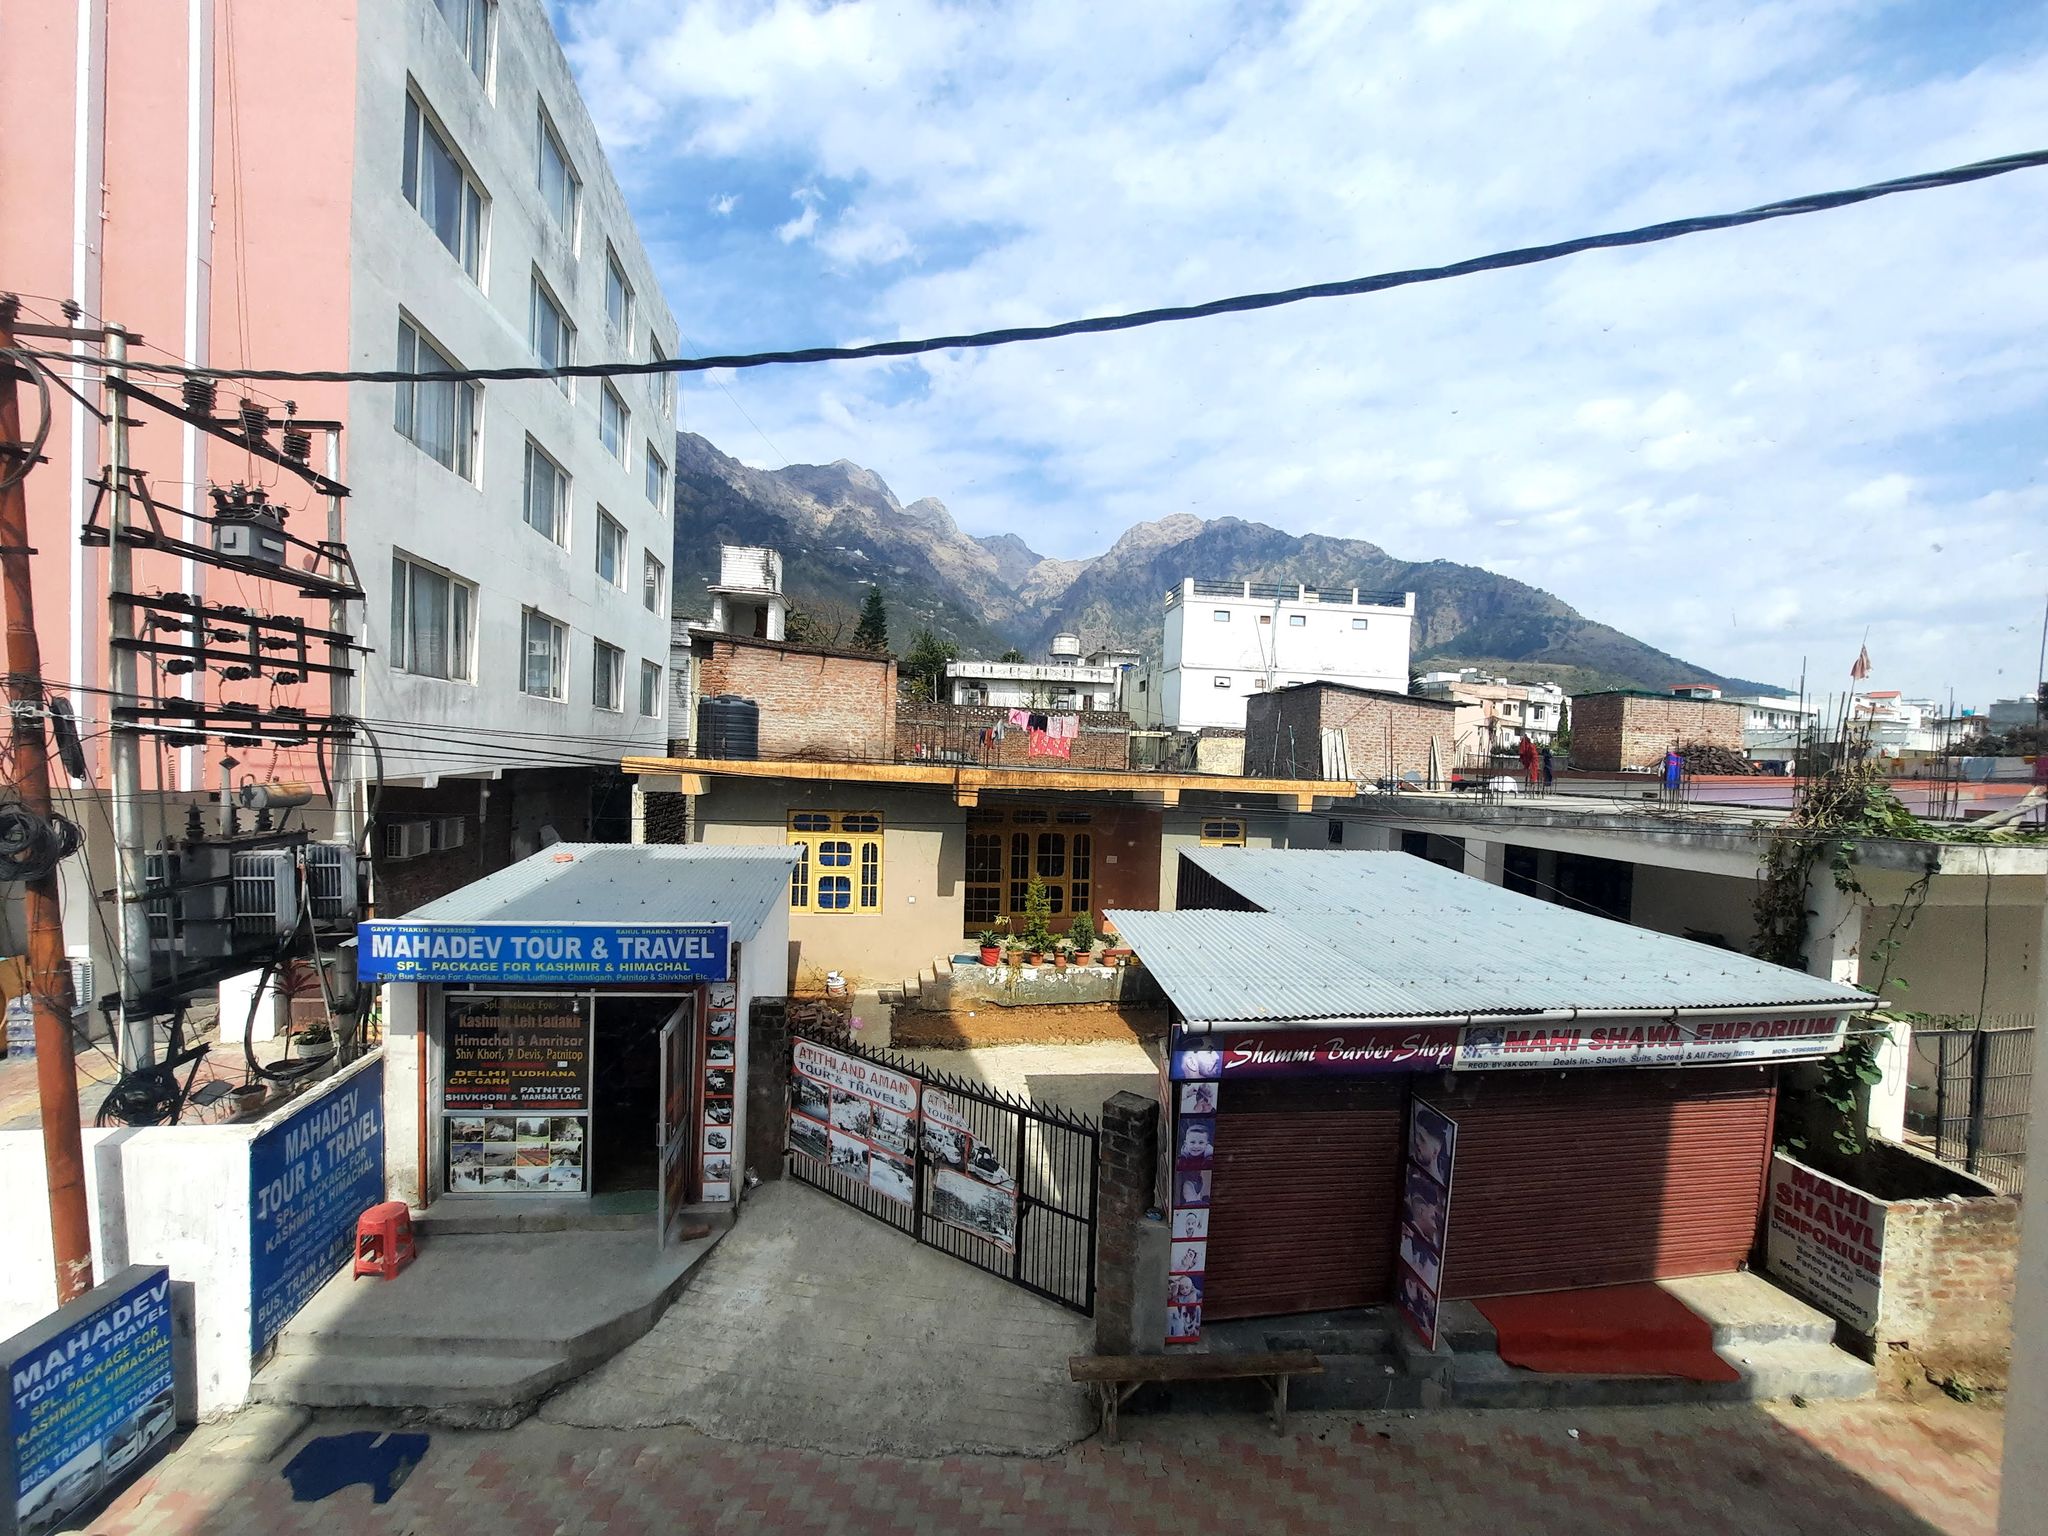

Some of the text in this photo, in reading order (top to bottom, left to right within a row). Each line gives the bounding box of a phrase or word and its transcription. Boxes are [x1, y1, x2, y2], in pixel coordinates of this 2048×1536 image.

[372, 935, 714, 960] MAHADEV TOUR & TRAVEL
[376, 972, 396, 980] Daily
[617, 974, 648, 982] Patnitop
[396, 962, 690, 972] SPL. PACKAGE FOR KASHMIR & HIMACHAL
[454, 1034, 583, 1046] Himachal & Amritsar
[1226, 1033, 1454, 1068] Shammi Barber Shop
[1504, 1016, 1837, 1054] MAHI SHAWL EMPORIUM
[456, 1048, 583, 1062] Shiv Khori, 9 Devis, Patnitop
[799, 1061, 830, 1080] TOUR
[835, 1075, 843, 1085] &
[800, 1046, 908, 1096] ATITHI AND AMAN
[1553, 1058, 1576, 1066] Deals
[1656, 1053, 1683, 1061] Sarees
[1707, 1051, 1730, 1060] Fancy
[285, 1088, 358, 1165] MAHADEV
[928, 1108, 953, 1122] TOUR
[257, 1160, 306, 1220] TOUR
[311, 1150, 322, 1181] &
[326, 1109, 378, 1168] TRAVEL
[266, 1203, 315, 1255] KASHMIR
[320, 1196, 326, 1211] &
[329, 1156, 374, 1203] HIMACHAL
[276, 1204, 299, 1230] SPL.
[302, 1162, 348, 1208] PACKAGE
[349, 1147, 366, 1170] FOR
[1791, 1166, 1869, 1220] MAHI
[1776, 1182, 1882, 1253] SHAWL
[1774, 1204, 1881, 1275] EMPORIUM
[258, 1294, 283, 1323] BUS,
[286, 1260, 316, 1296] TRAIN
[320, 1253, 326, 1268] &
[328, 1235, 344, 1260] AIR
[1796, 1245, 1827, 1268] Sarees
[1840, 1272, 1853, 1283] All
[1797, 1255, 1823, 1277] Fancy
[264, 1298, 295, 1332] GAVVY
[13, 1279, 169, 1395] MAHADEV
[15, 1305, 168, 1410] TOUR & TRAVEL
[31, 1325, 158, 1422] SPL. PACKAGE FOR
[17, 1334, 170, 1450] KASHMIR & HIMACHAL
[20, 1371, 171, 1494] BUS, TRAIN & AIR TICKETS
[21, 1429, 58, 1461] GAVVY
[20, 1441, 60, 1474] RAHUL
